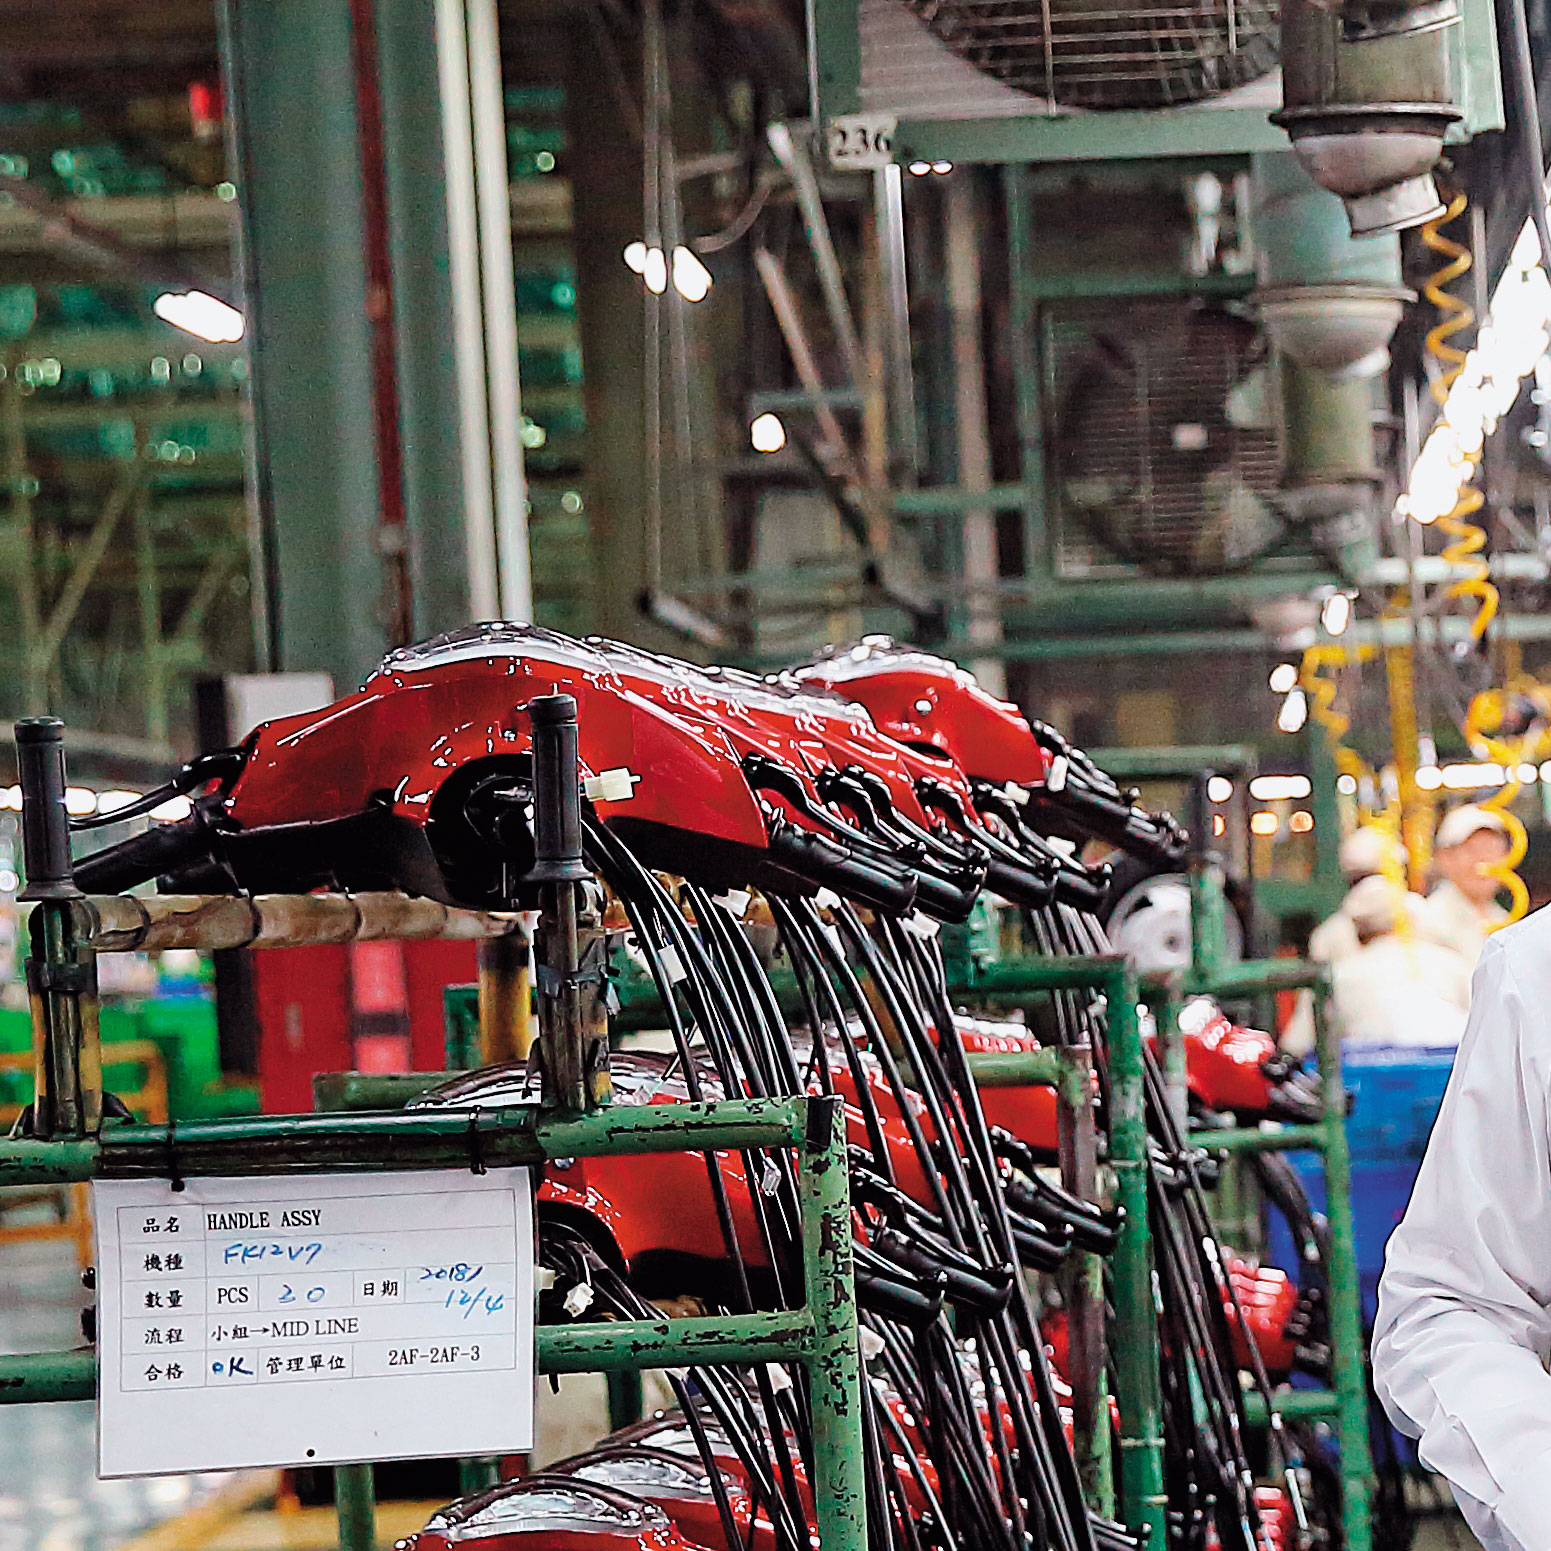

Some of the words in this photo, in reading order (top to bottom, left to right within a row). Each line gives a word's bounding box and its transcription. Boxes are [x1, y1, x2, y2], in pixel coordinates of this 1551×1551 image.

[142, 1216, 181, 1234] 品名
[207, 1211, 270, 1231] HANDLE
[281, 1209, 322, 1227] ASSY
[143, 1253, 185, 1272] 機種
[217, 1287, 249, 1305] PCS
[363, 1280, 399, 1297] 日期
[144, 1290, 184, 1309] 數量
[144, 1327, 185, 1345] 流程
[315, 1317, 360, 1336] LINE
[266, 1354, 347, 1376] 管理單位
[388, 1345, 481, 1366] 2AF-2AF-3
[144, 1362, 185, 1382] 合格
